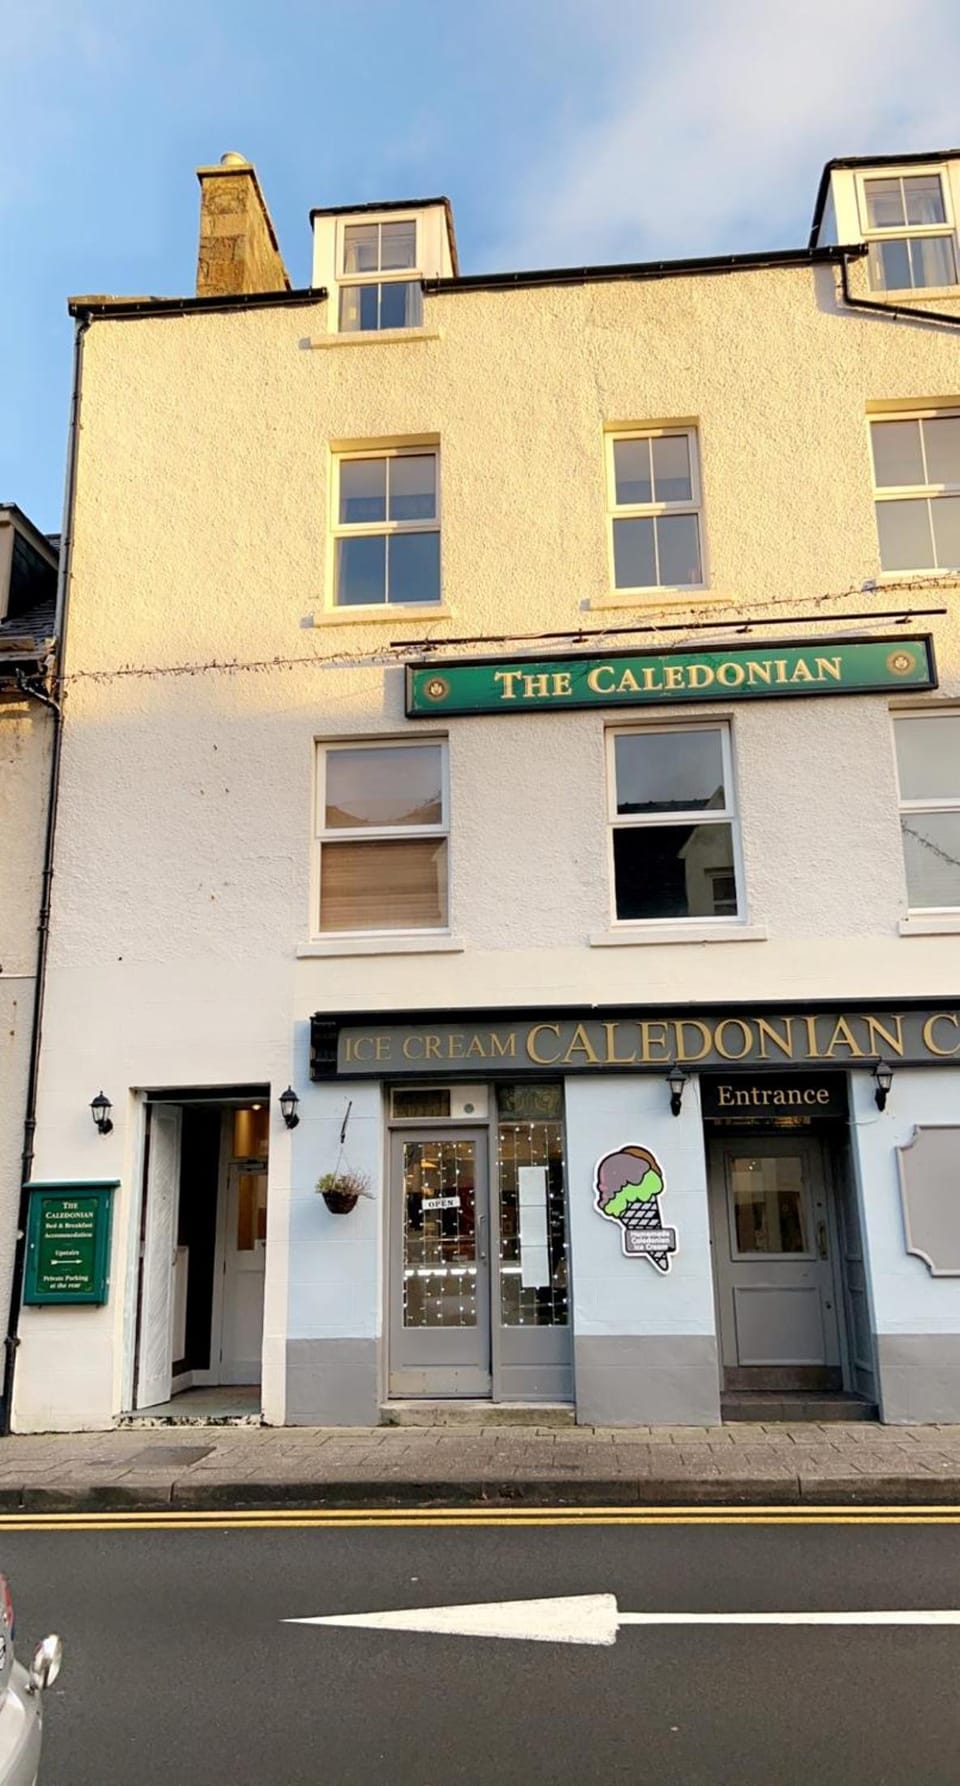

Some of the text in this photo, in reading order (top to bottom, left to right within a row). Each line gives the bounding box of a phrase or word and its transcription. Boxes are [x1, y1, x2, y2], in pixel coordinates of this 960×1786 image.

[494, 656, 844, 699] THE CALEDONIAN
[343, 1032, 517, 1062] ICE CREAM
[526, 1014, 905, 1065] CALEDONIAN
[717, 1085, 831, 1107] Entrance
[63, 1201, 78, 1210] THE
[428, 1199, 454, 1208] OPEN
[45, 1211, 94, 1219] CALEDONIAN
[65, 1274, 89, 1282] Parking
